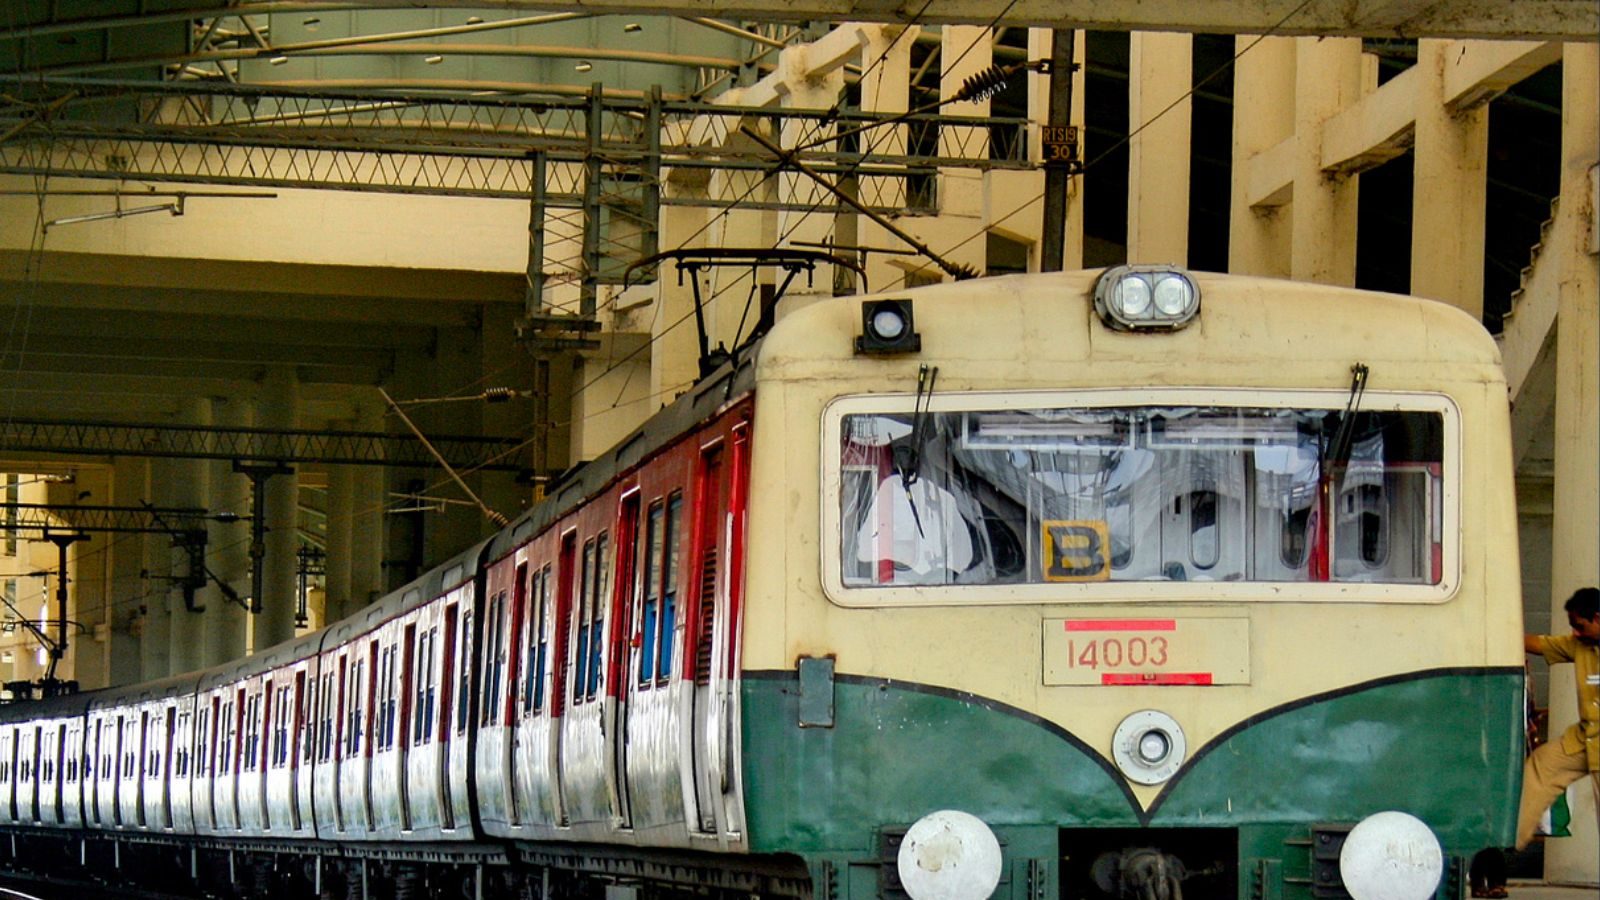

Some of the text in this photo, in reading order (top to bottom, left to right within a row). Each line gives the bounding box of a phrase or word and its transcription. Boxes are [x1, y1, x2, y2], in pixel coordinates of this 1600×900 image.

[1051, 144, 1070, 159] 30
[1047, 526, 1104, 576] B
[1068, 636, 1168, 670] 14003
